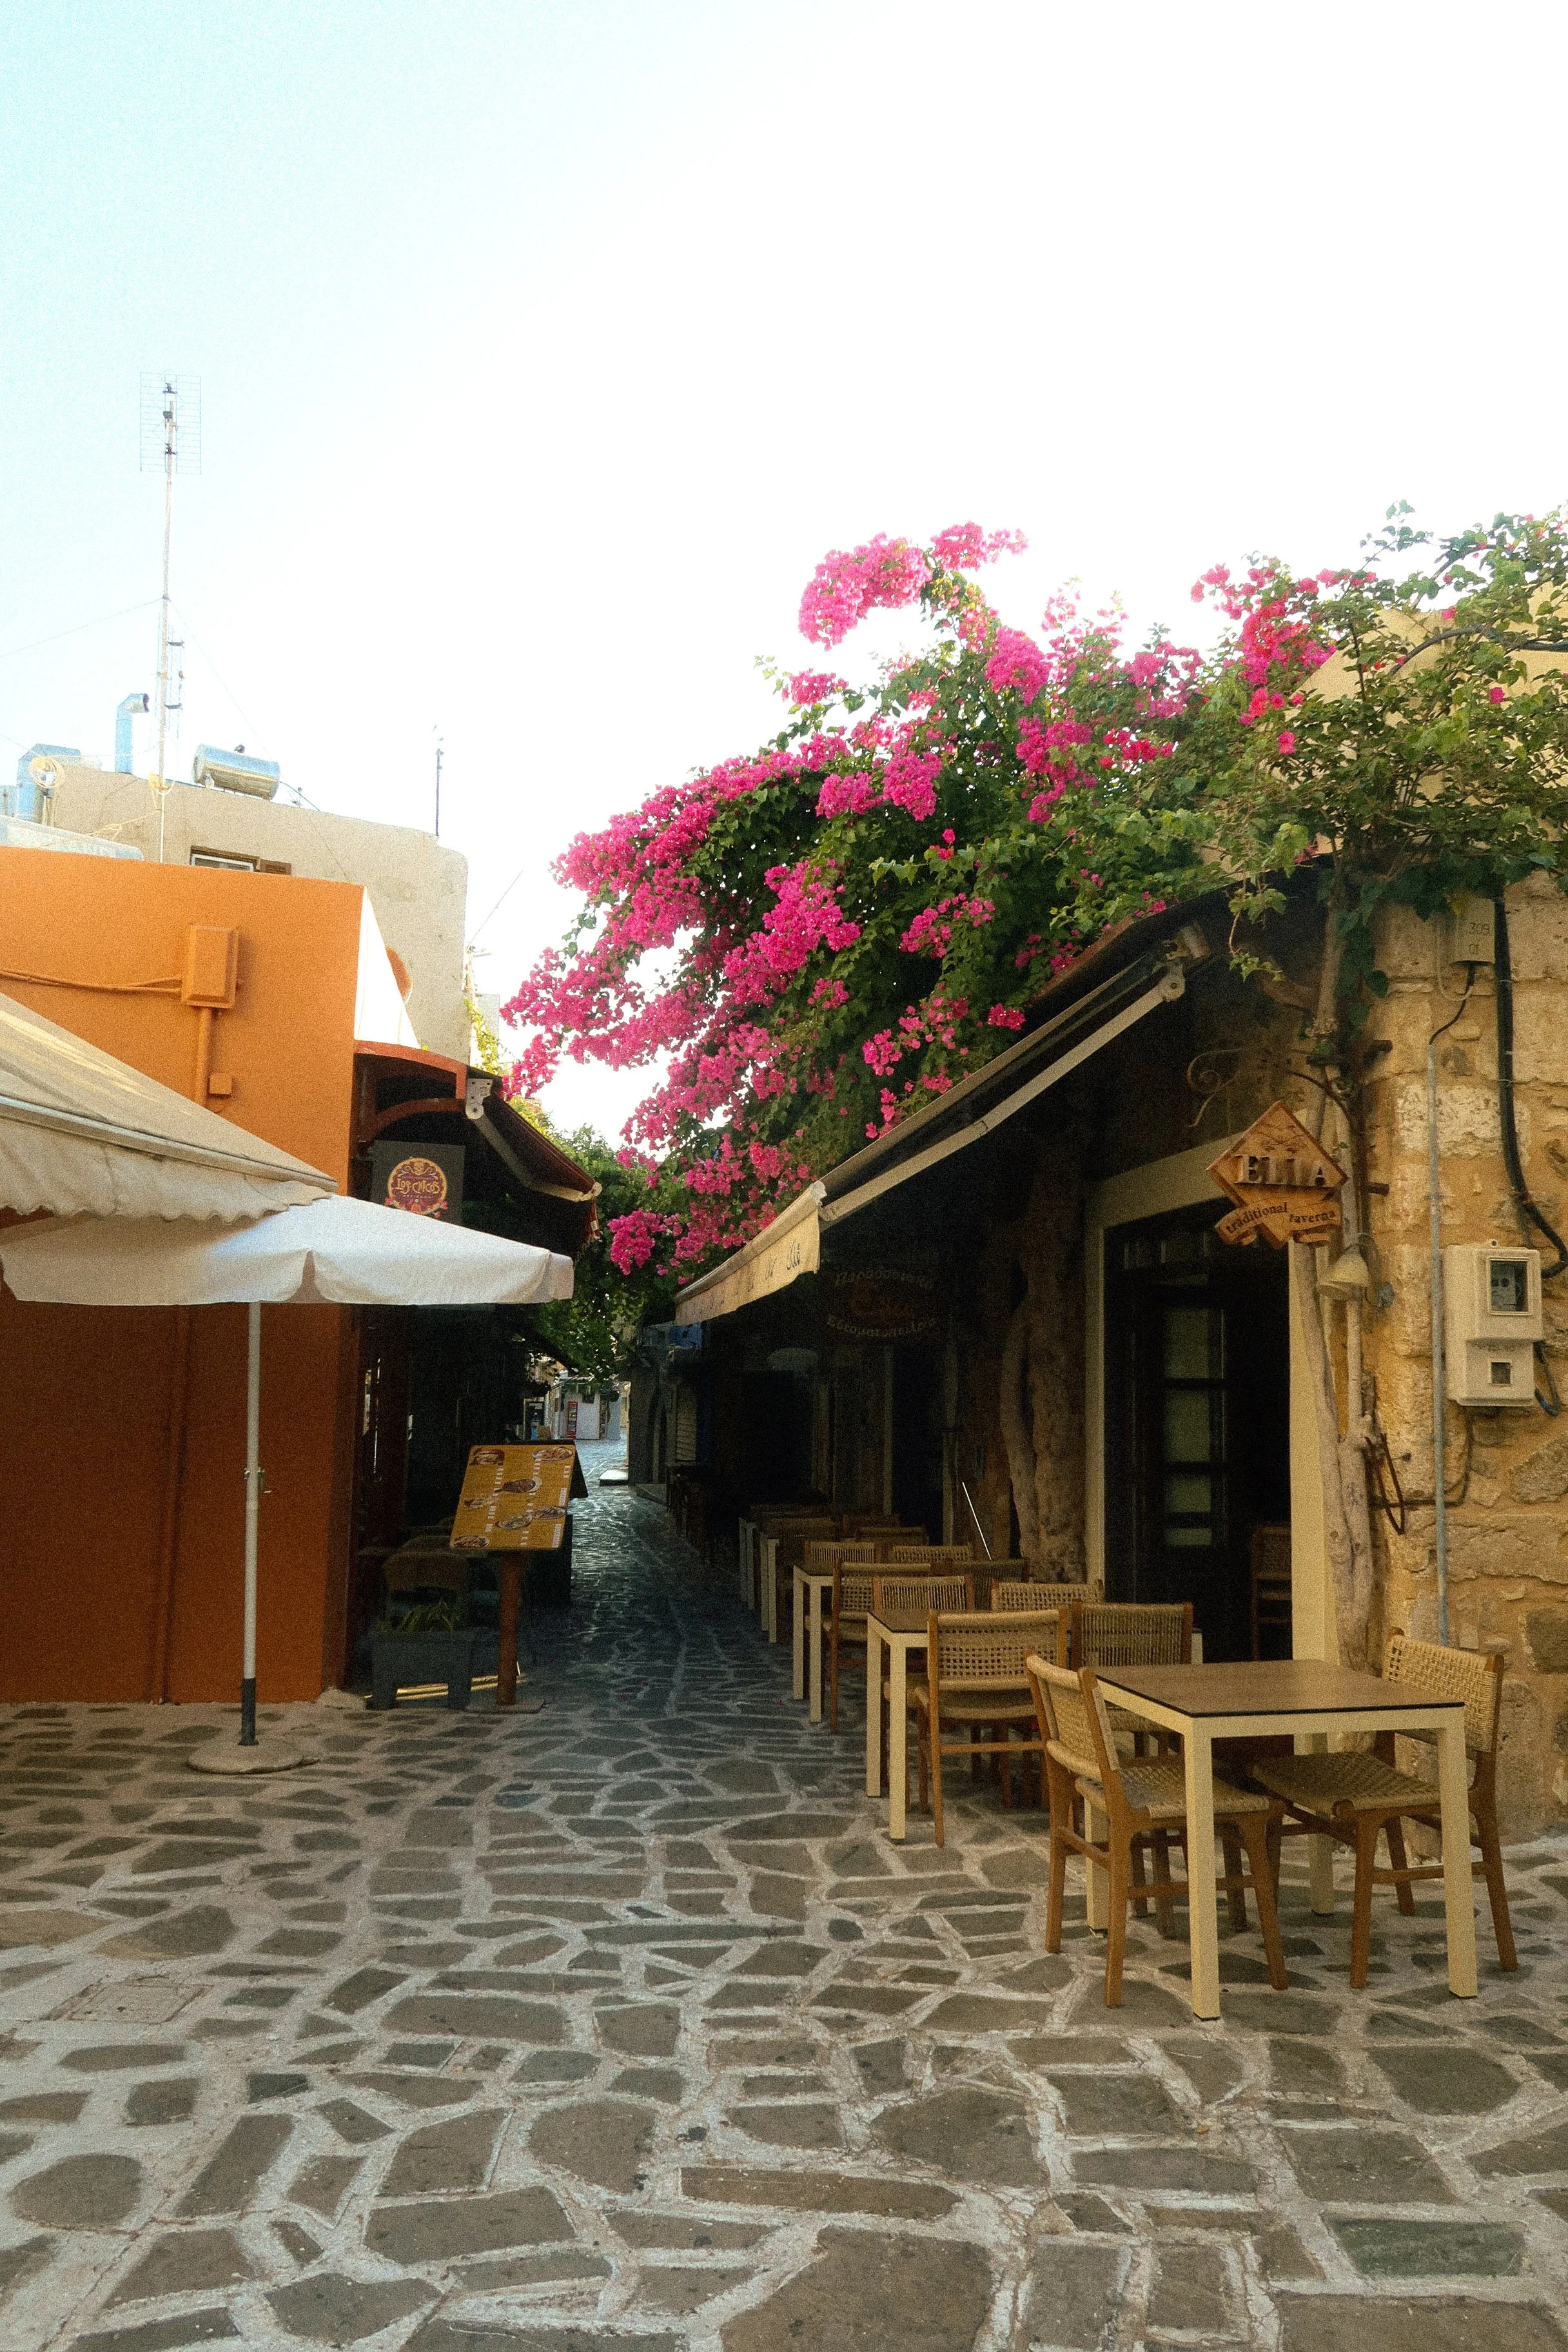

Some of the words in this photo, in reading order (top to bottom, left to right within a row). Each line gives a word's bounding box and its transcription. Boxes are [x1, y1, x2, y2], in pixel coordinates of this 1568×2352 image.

[1469, 922, 1490, 936] 309
[1233, 1155, 1333, 1188] ELIA
[1226, 1202, 1288, 1234] traditional
[1289, 1209, 1337, 1224] taverna
